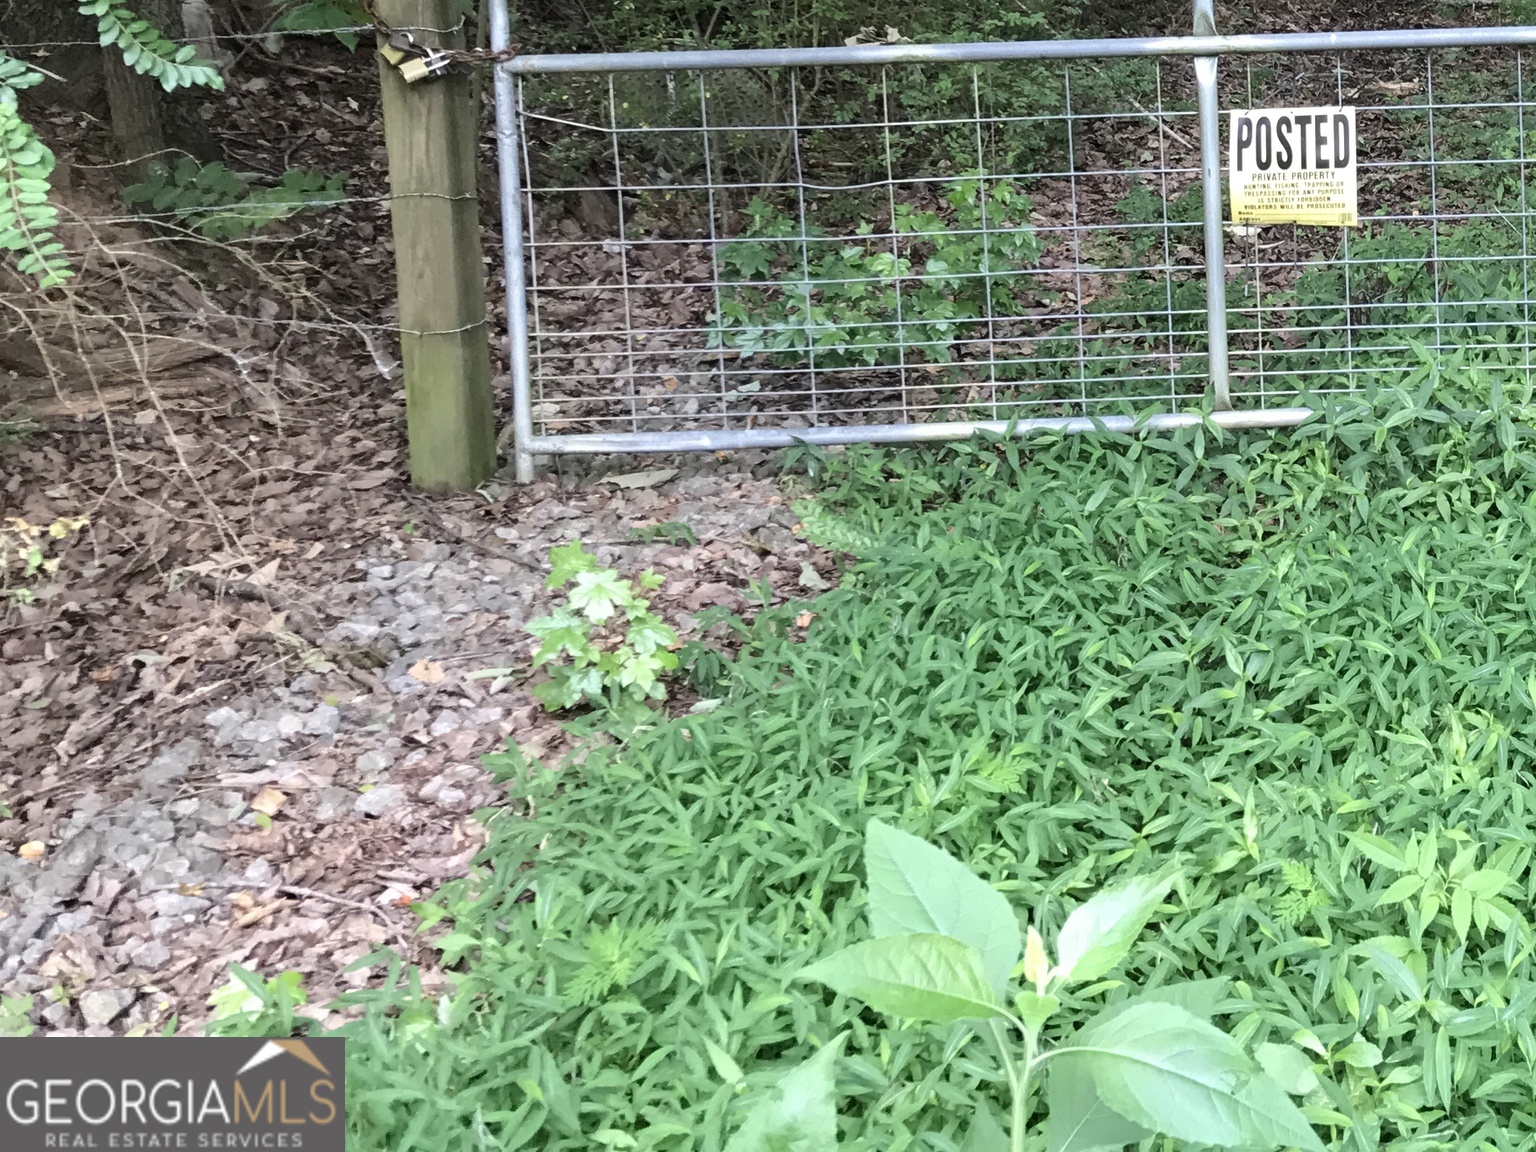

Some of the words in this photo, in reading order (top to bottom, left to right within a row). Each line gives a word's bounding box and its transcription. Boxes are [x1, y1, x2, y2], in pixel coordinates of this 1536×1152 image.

[1237, 113, 1350, 172] POSTED
[1252, 173, 1287, 182] PRIVATE
[1292, 171, 1335, 180] PROPERTY
